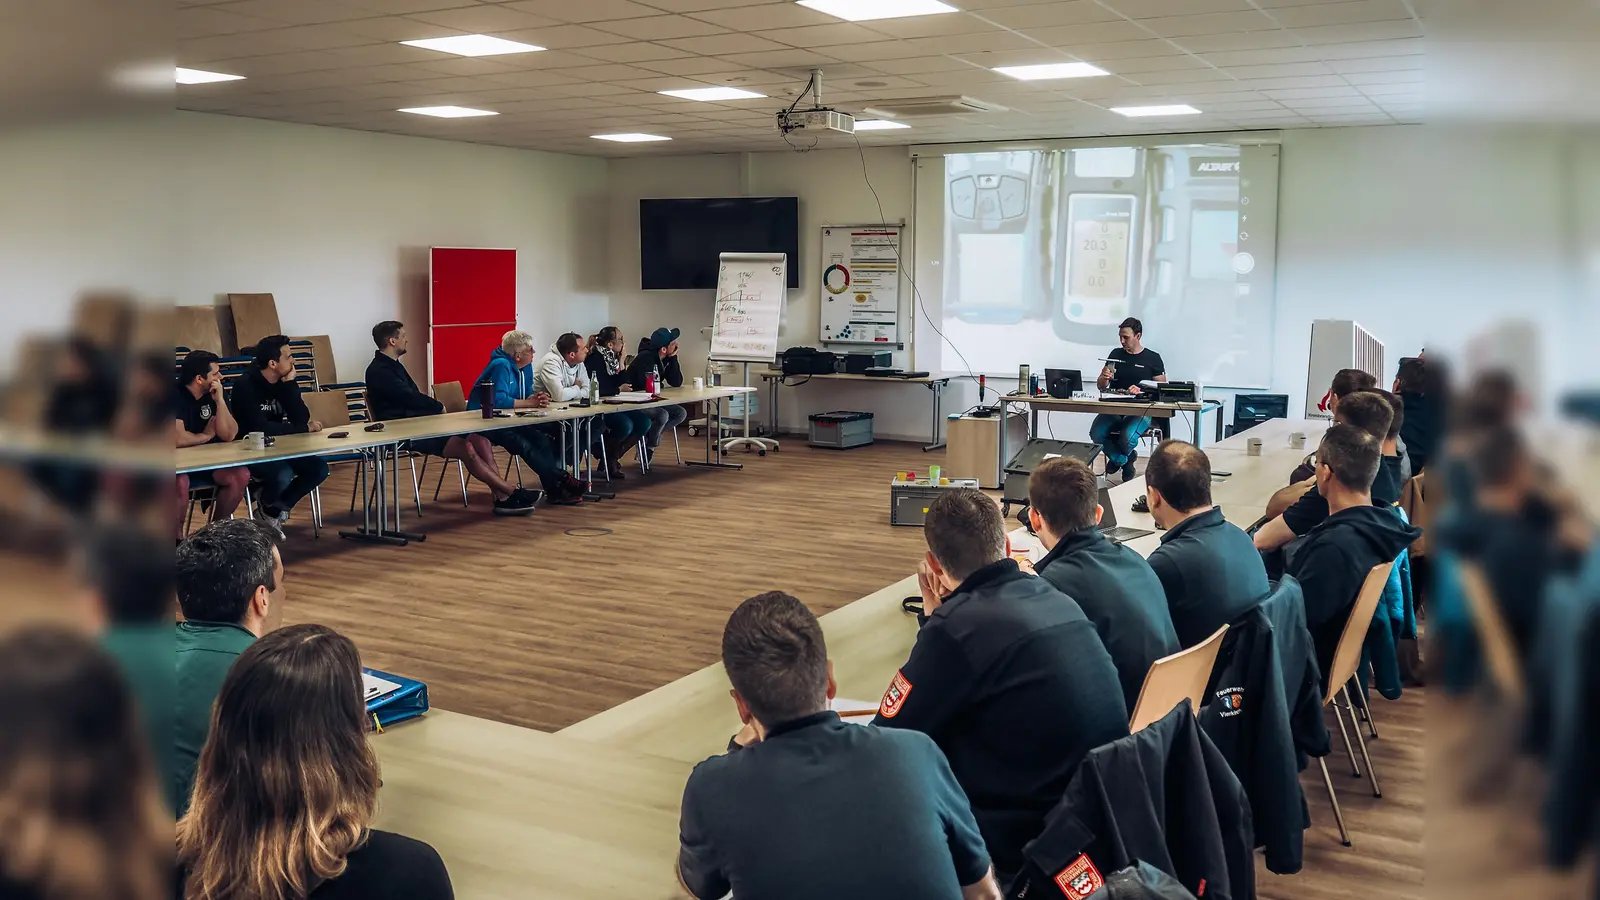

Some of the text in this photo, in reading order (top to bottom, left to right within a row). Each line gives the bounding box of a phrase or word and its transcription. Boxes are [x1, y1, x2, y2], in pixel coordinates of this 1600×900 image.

[1197, 162, 1234, 172] ALTAIR
[1083, 239, 1108, 251] 20.3
[1216, 687, 1245, 698] Feuerweh
